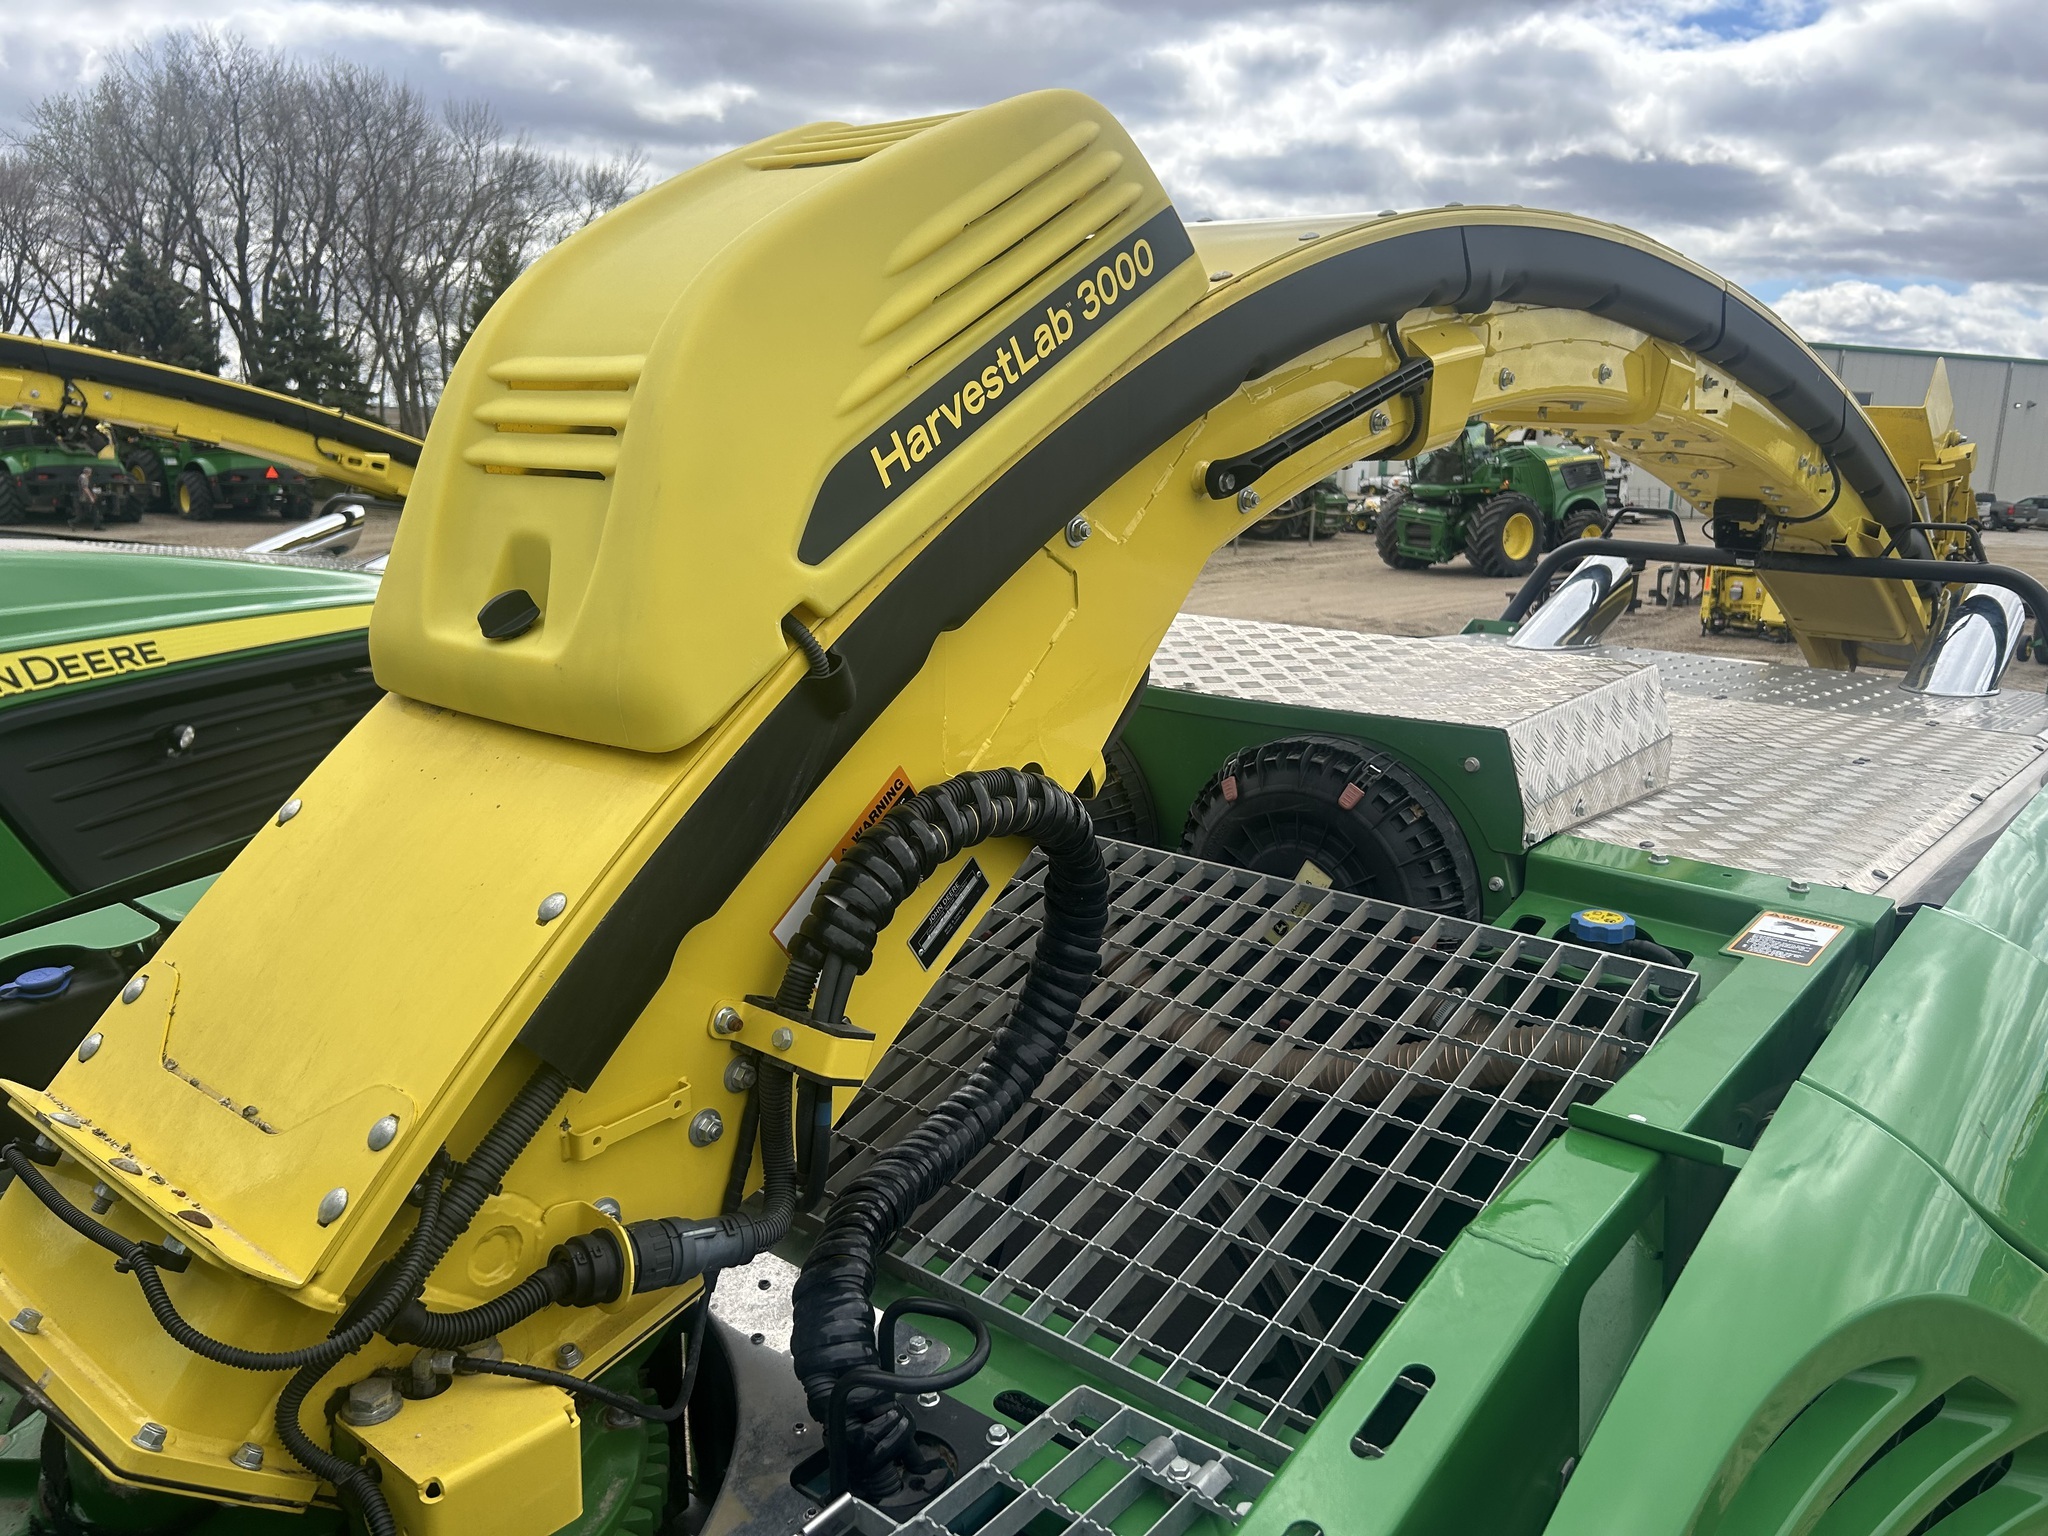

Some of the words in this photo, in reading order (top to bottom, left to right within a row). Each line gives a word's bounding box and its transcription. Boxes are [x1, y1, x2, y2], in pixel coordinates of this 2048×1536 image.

[1076, 238, 1154, 321] 3000
[18, 640, 166, 685] DEERE
[851, 778, 905, 843] WARNING
[928, 904, 944, 924] JOHN
[942, 881, 961, 905] DEERE
[1782, 914, 1840, 930] WARNING
